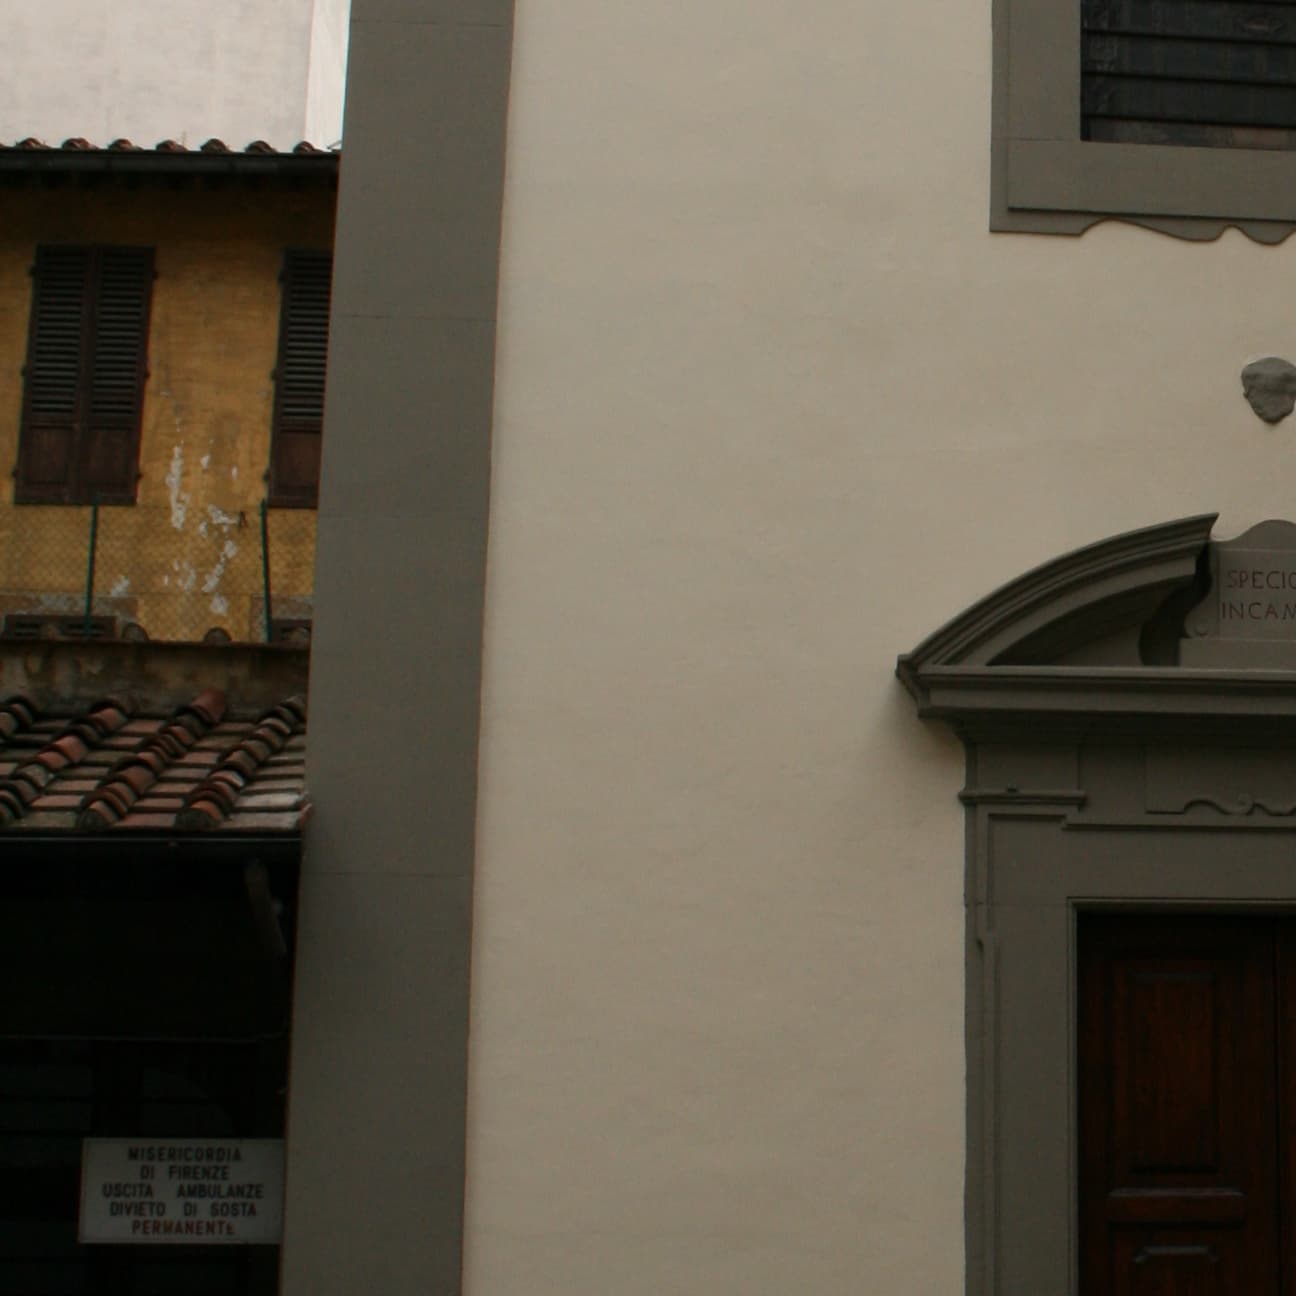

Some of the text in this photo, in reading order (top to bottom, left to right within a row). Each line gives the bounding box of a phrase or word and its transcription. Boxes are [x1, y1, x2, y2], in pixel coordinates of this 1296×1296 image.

[127, 1146, 242, 1162] MISERICORDIA
[140, 1165, 230, 1180] DI FIRENZE
[102, 1184, 264, 1199] USCITA AMBULANZE
[110, 1202, 256, 1216] DIVIETO DI SOSTA
[131, 1220, 236, 1235] PERMANENTE
